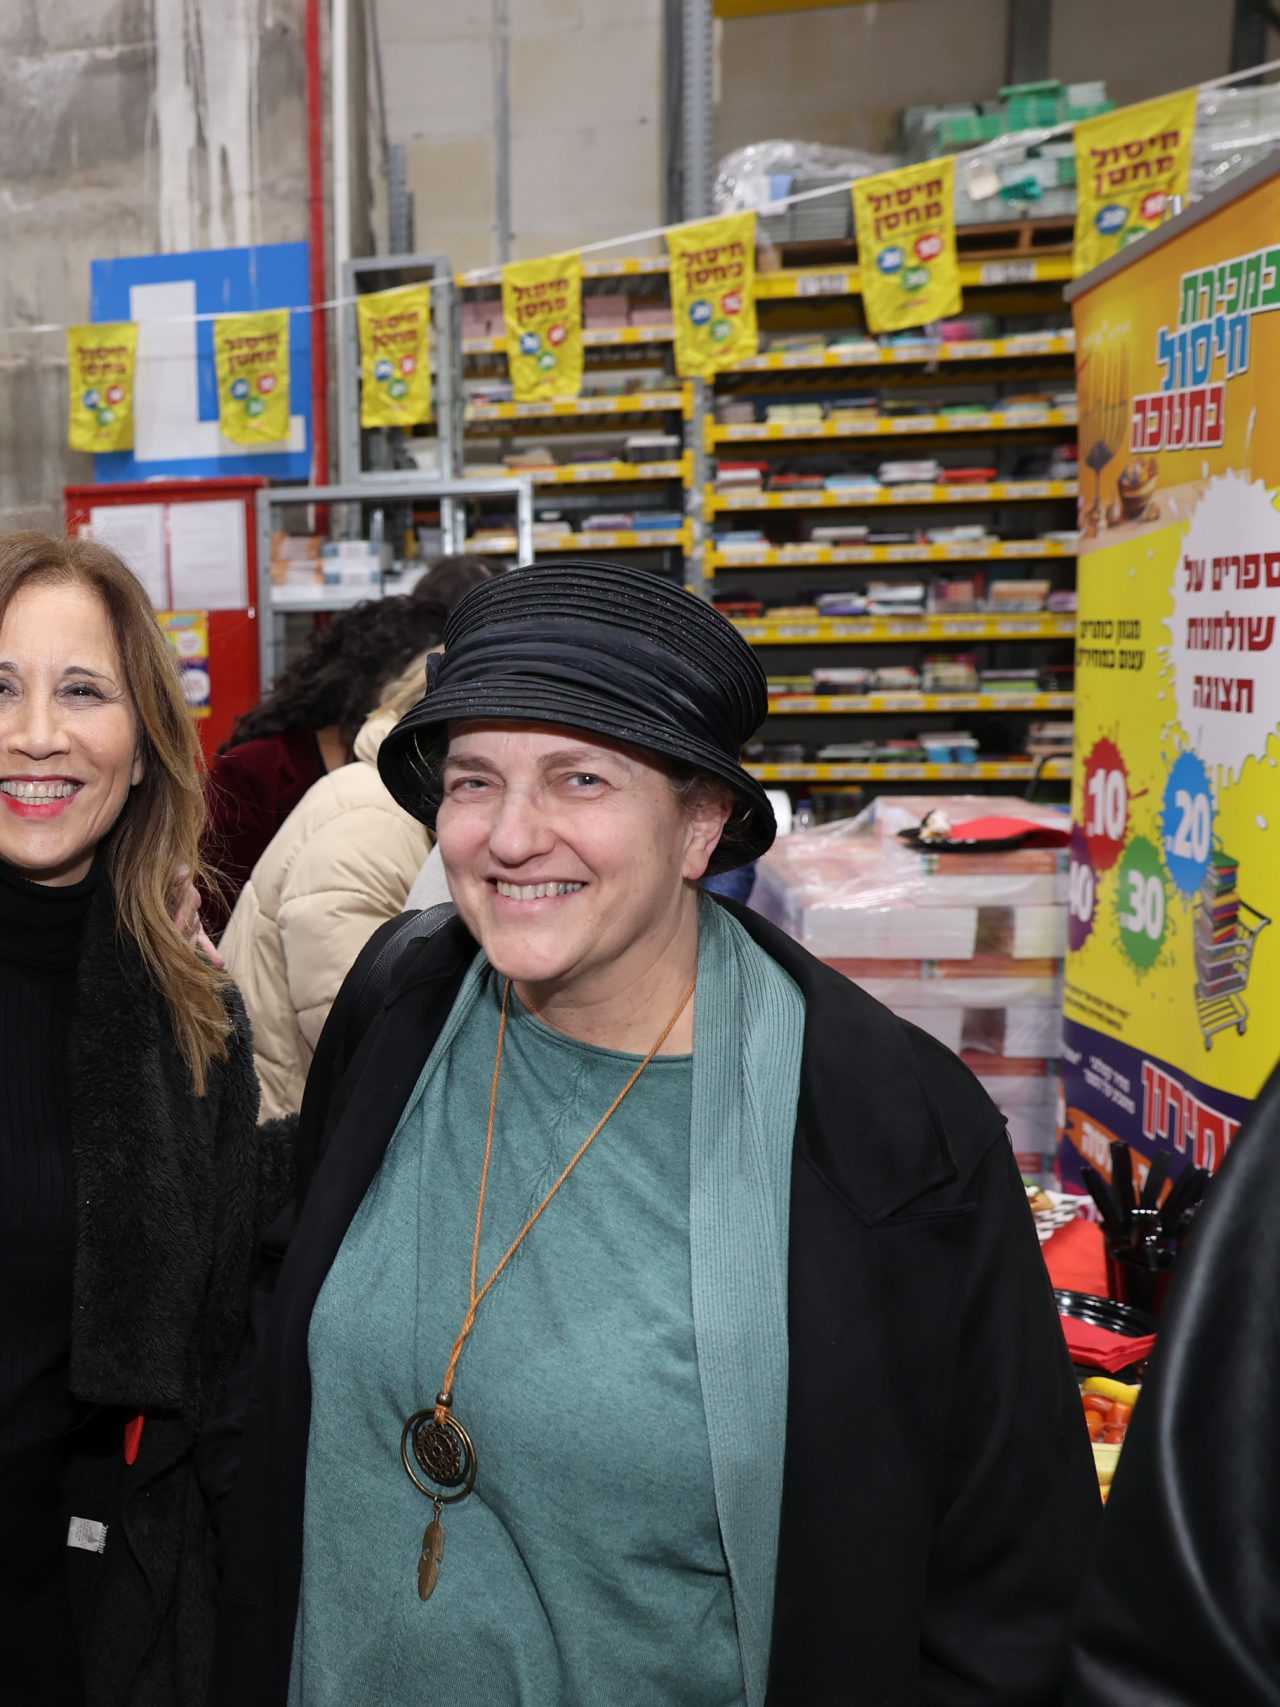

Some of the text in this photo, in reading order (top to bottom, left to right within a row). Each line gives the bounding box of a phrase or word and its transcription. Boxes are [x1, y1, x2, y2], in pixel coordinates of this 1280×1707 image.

[1090, 130, 1180, 169] חיסול
[868, 177, 943, 212] חיסול
[1093, 155, 1174, 197] מחסן
[874, 201, 943, 240] מחסן
[680, 241, 744, 267] חיסול
[1178, 243, 1280, 330] במכירת
[1156, 312, 1251, 392] חיסול
[1129, 381, 1226, 453] בחנוכה
[1184, 552, 1280, 592] ספרים על
[1186, 610, 1276, 652] שולחנות
[1193, 675, 1256, 714] תצוגה
[1174, 789, 1211, 864] 20
[1127, 869, 1165, 940] 30
